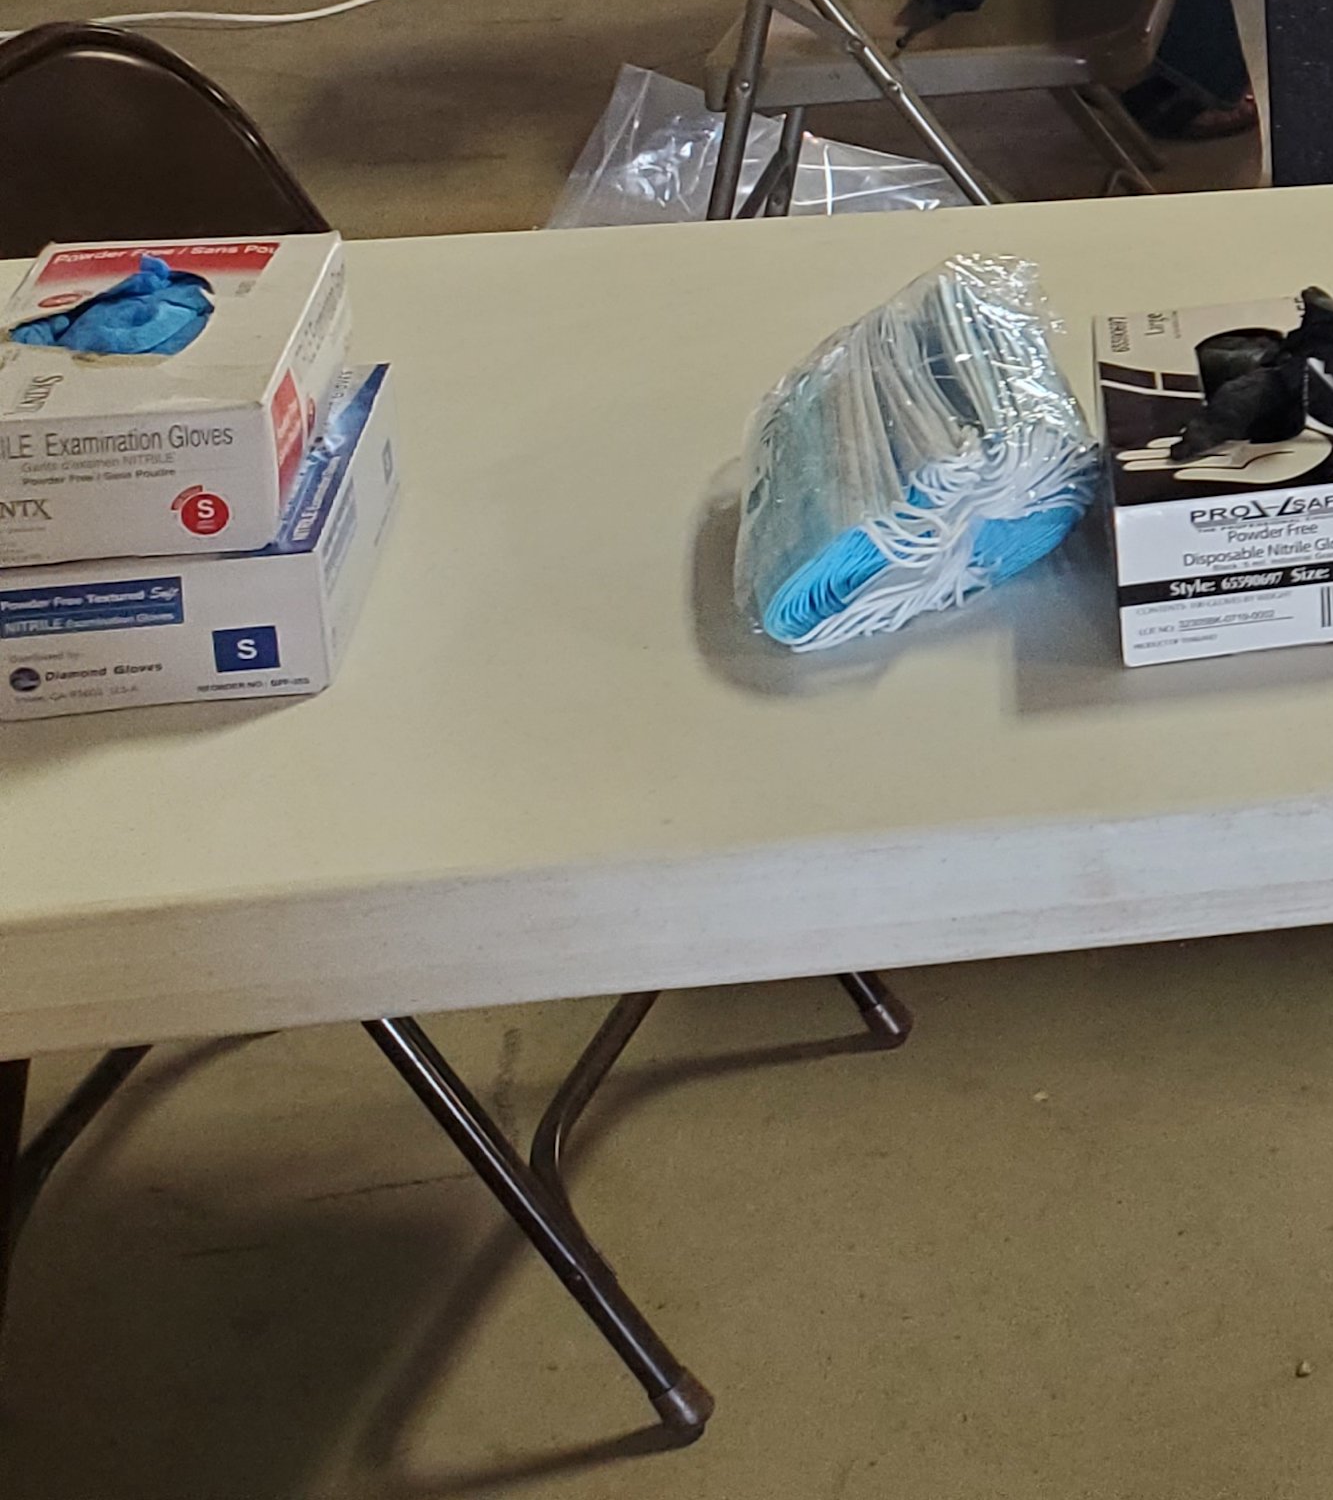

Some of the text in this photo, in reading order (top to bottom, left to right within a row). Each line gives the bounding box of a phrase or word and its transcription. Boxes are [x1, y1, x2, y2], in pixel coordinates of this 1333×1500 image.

[53, 248, 127, 265] Powder
[190, 245, 238, 255] Sans
[46, 428, 163, 457] Examination
[168, 425, 233, 449] Gloves
[197, 498, 215, 519] S
[1228, 525, 1284, 543] Powder
[1287, 523, 1319, 537] Free
[1183, 547, 1265, 567] Disposable
[1268, 541, 1311, 556] Nitrile
[1169, 579, 1217, 598] Style:
[1291, 566, 1330, 583] Size:
[237, 638, 258, 660] S
[45, 663, 163, 682] Diamond Gloves
